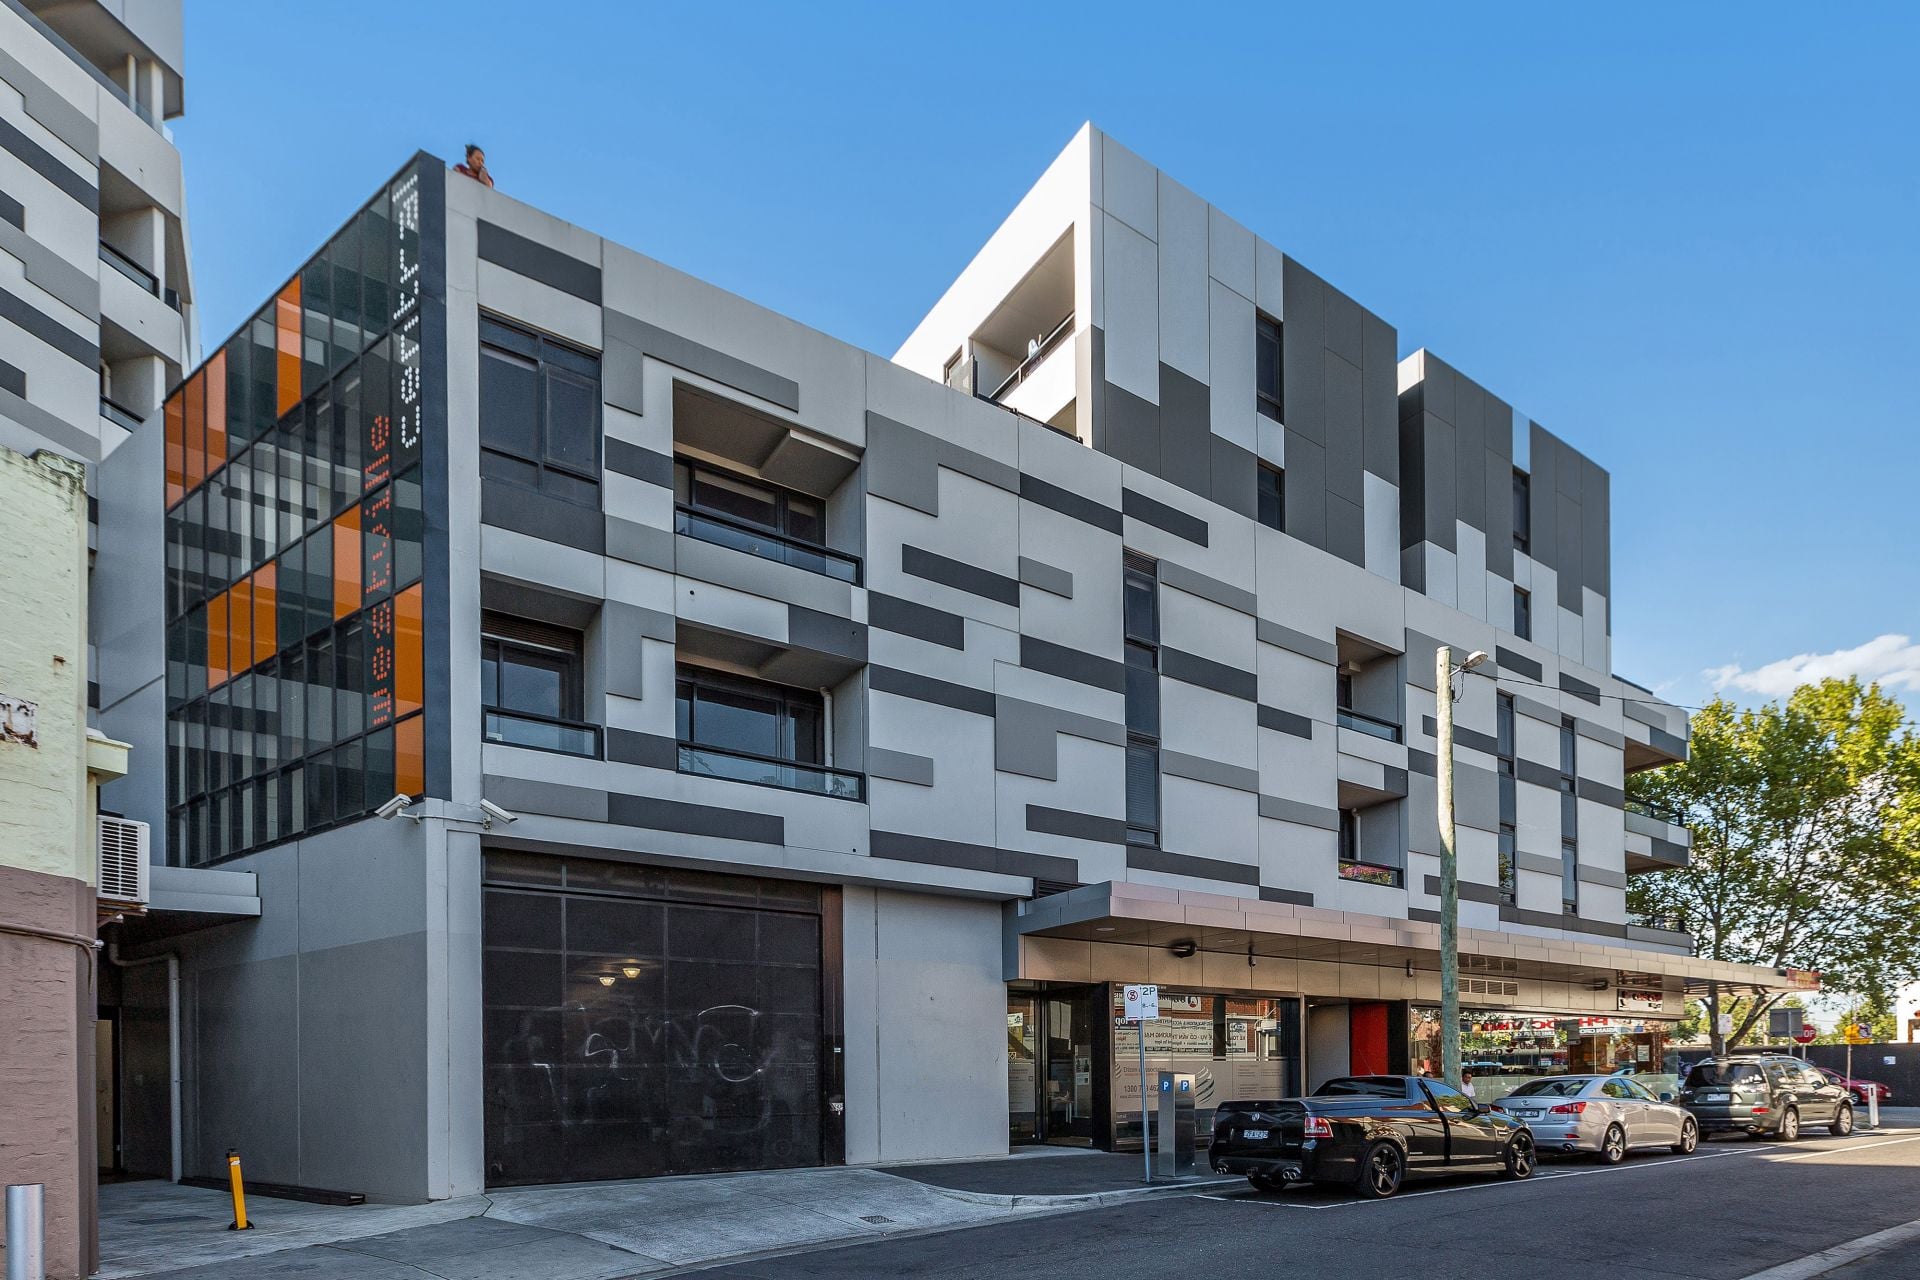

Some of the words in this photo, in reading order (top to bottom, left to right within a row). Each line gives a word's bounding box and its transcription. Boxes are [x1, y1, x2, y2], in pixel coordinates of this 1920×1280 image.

[1142, 987, 1156, 996] 2P
[1803, 1029, 1815, 1038] OP
[1163, 1081, 1169, 1091] P
[1182, 1081, 1188, 1091] P
